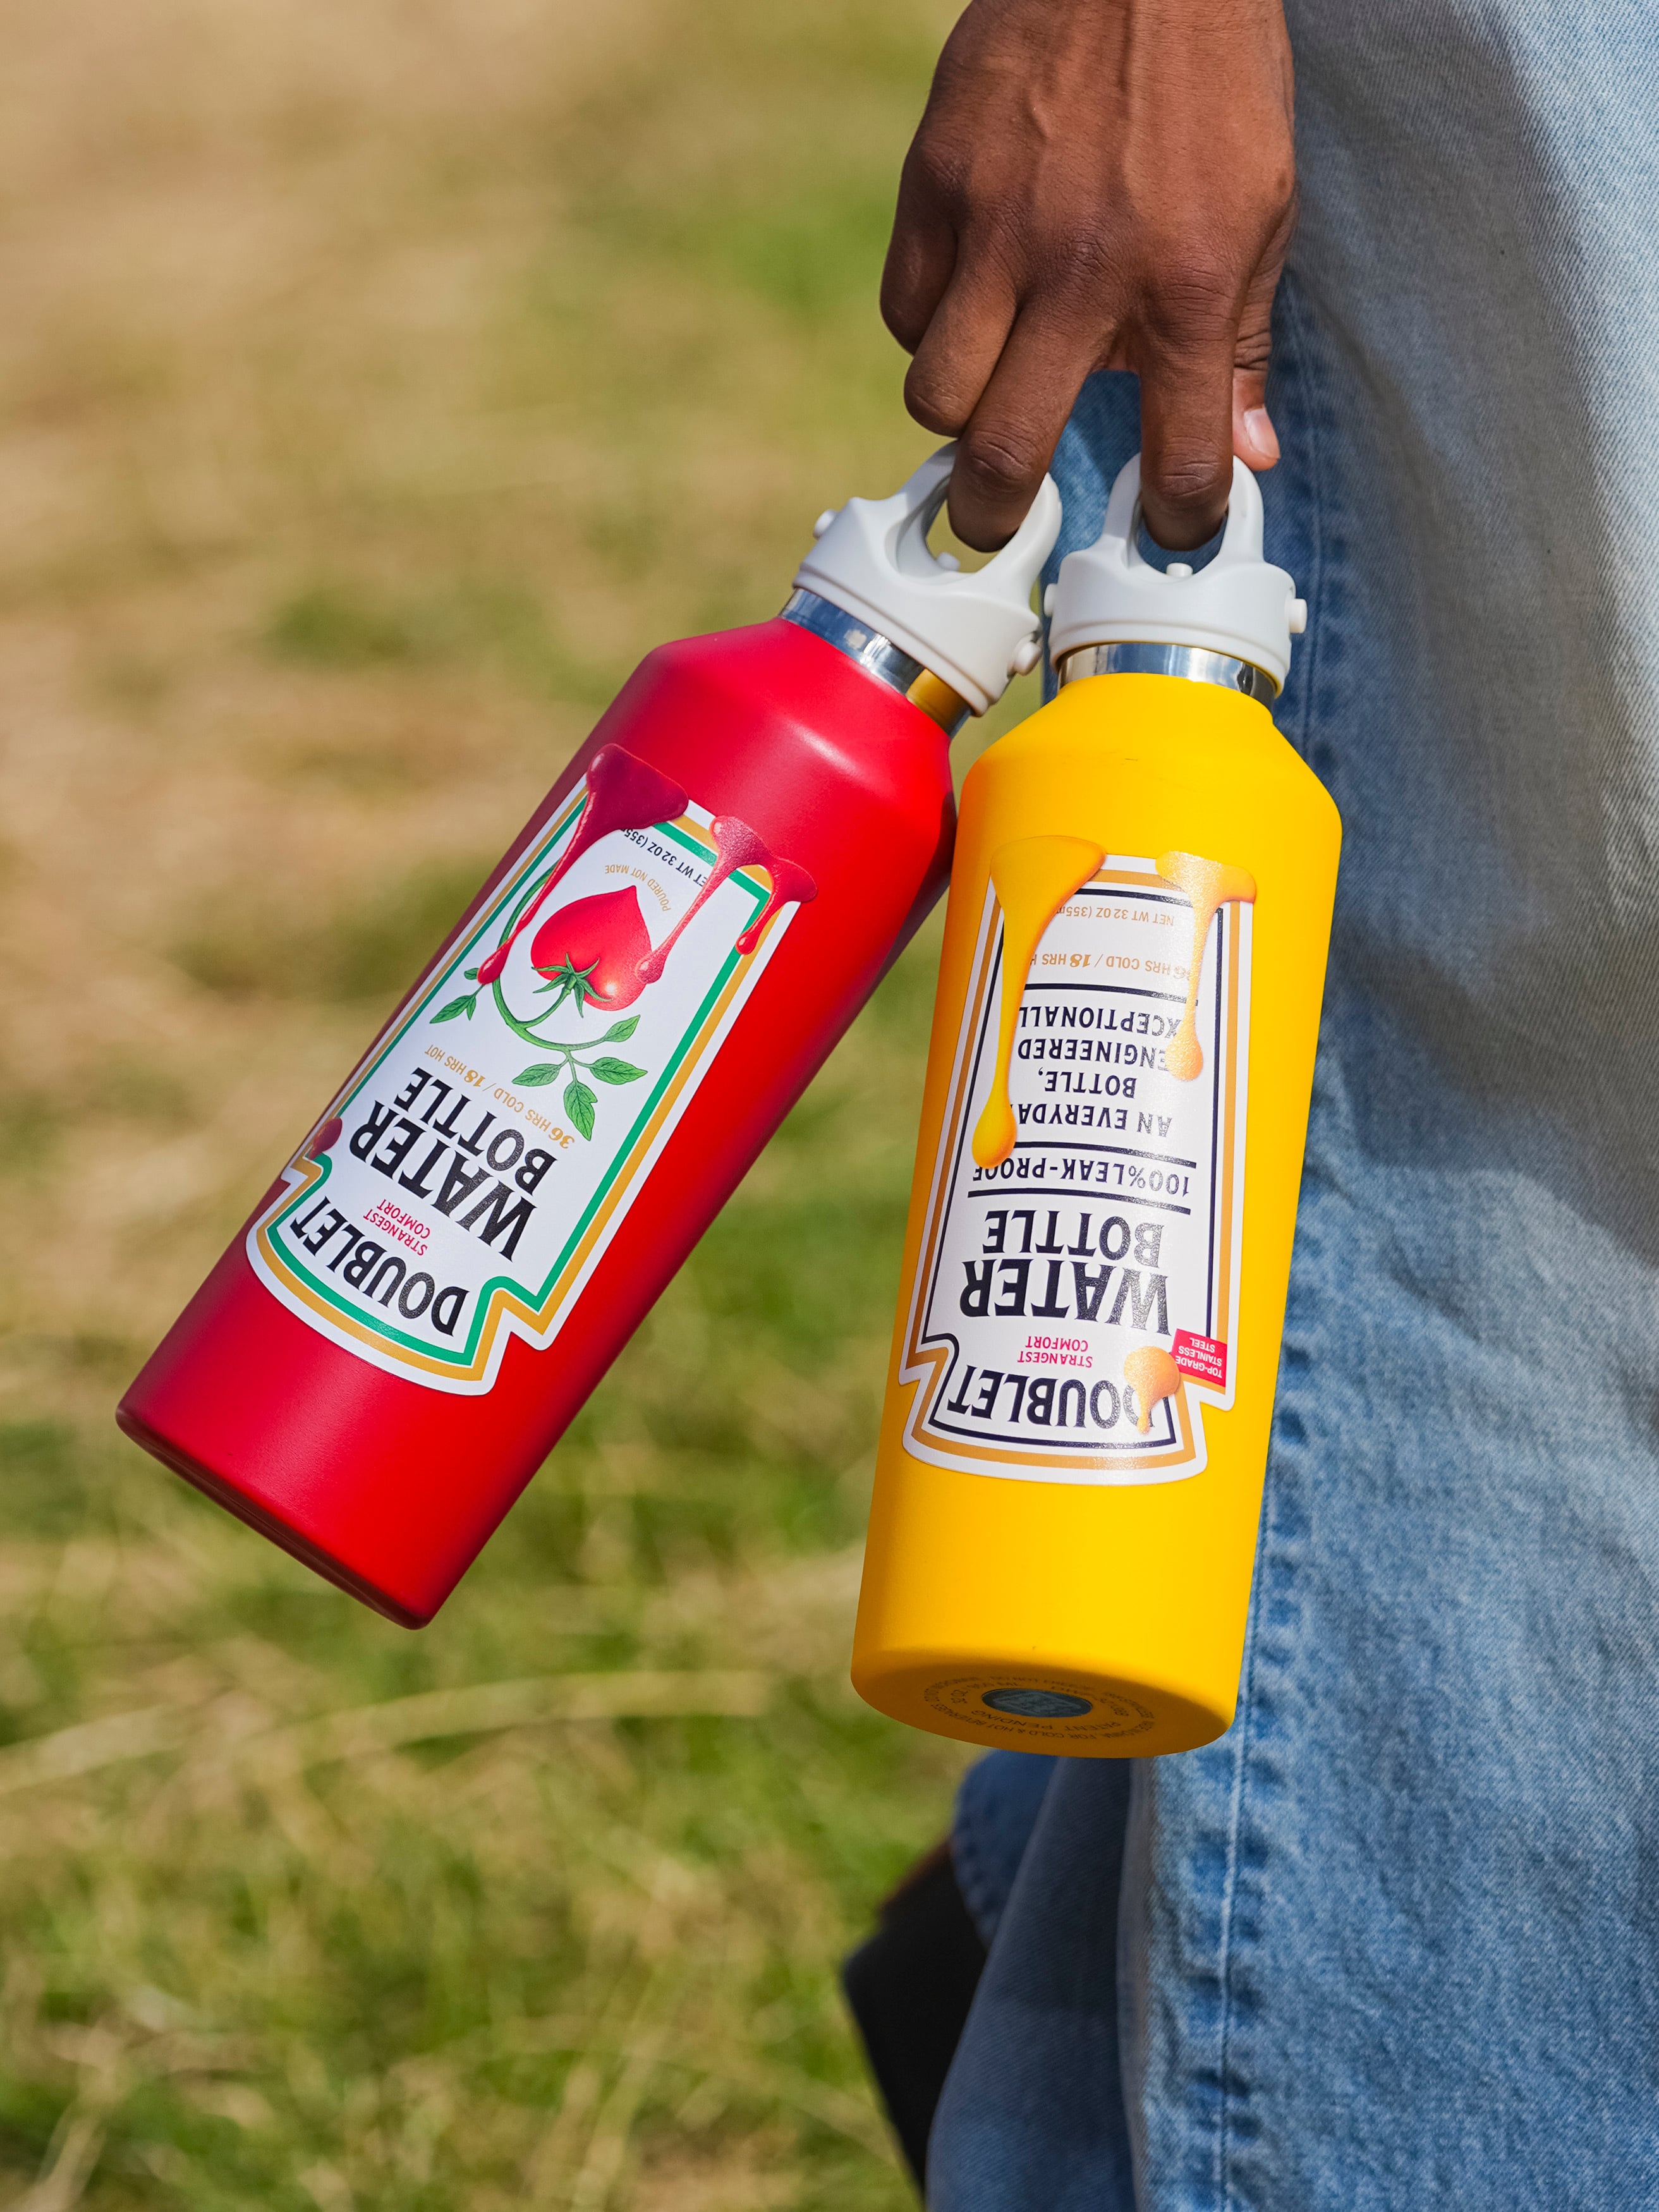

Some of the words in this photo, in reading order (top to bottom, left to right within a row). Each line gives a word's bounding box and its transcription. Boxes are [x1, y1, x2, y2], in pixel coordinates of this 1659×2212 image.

[647, 841, 663, 856] OZ
[661, 851, 676, 865] 32
[605, 864, 629, 874] MADE
[630, 868, 647, 881] NOT
[675, 861, 693, 878] WT
[693, 873, 708, 887] ET
[647, 878, 671, 911] POURED
[1096, 908, 1111, 918] OZ
[1112, 908, 1129, 920] 32
[1131, 911, 1149, 922] WT
[1152, 914, 1174, 926] NET
[1042, 954, 1067, 966] HRS
[1069, 954, 1091, 968] 18
[1105, 956, 1140, 970] COLD
[1145, 960, 1170, 975] HRS
[1015, 1006, 1181, 1038] XCEPTIONALL
[423, 1044, 445, 1061] HOT
[444, 1055, 467, 1074] HRS
[464, 1069, 485, 1086] 18
[1038, 1067, 1137, 1099] BOTTLE,
[493, 1087, 524, 1112] COLD
[525, 1109, 551, 1132] HRS
[1010, 1103, 1128, 1131] EVERYDA
[1136, 1111, 1173, 1138] AN
[393, 1067, 557, 1196] BOTTLE
[548, 1127, 574, 1148] 36
[348, 1100, 537, 1261] WATER
[376, 1198, 430, 1239] COMFORT
[363, 1208, 427, 1256] STRANGEST
[981, 1210, 1165, 1269] BOTTLE
[289, 1195, 470, 1337] DOUBLET
[959, 1258, 1171, 1337] WATER
[1025, 1336, 1088, 1352] COMFORT
[1189, 1337, 1215, 1353] STEEL
[1017, 1351, 1093, 1368] STRANGEST
[1178, 1346, 1222, 1367] STAINLESS
[1175, 1355, 1222, 1378] TOP-GRADE
[970, 1710, 1054, 1730] PENDING
